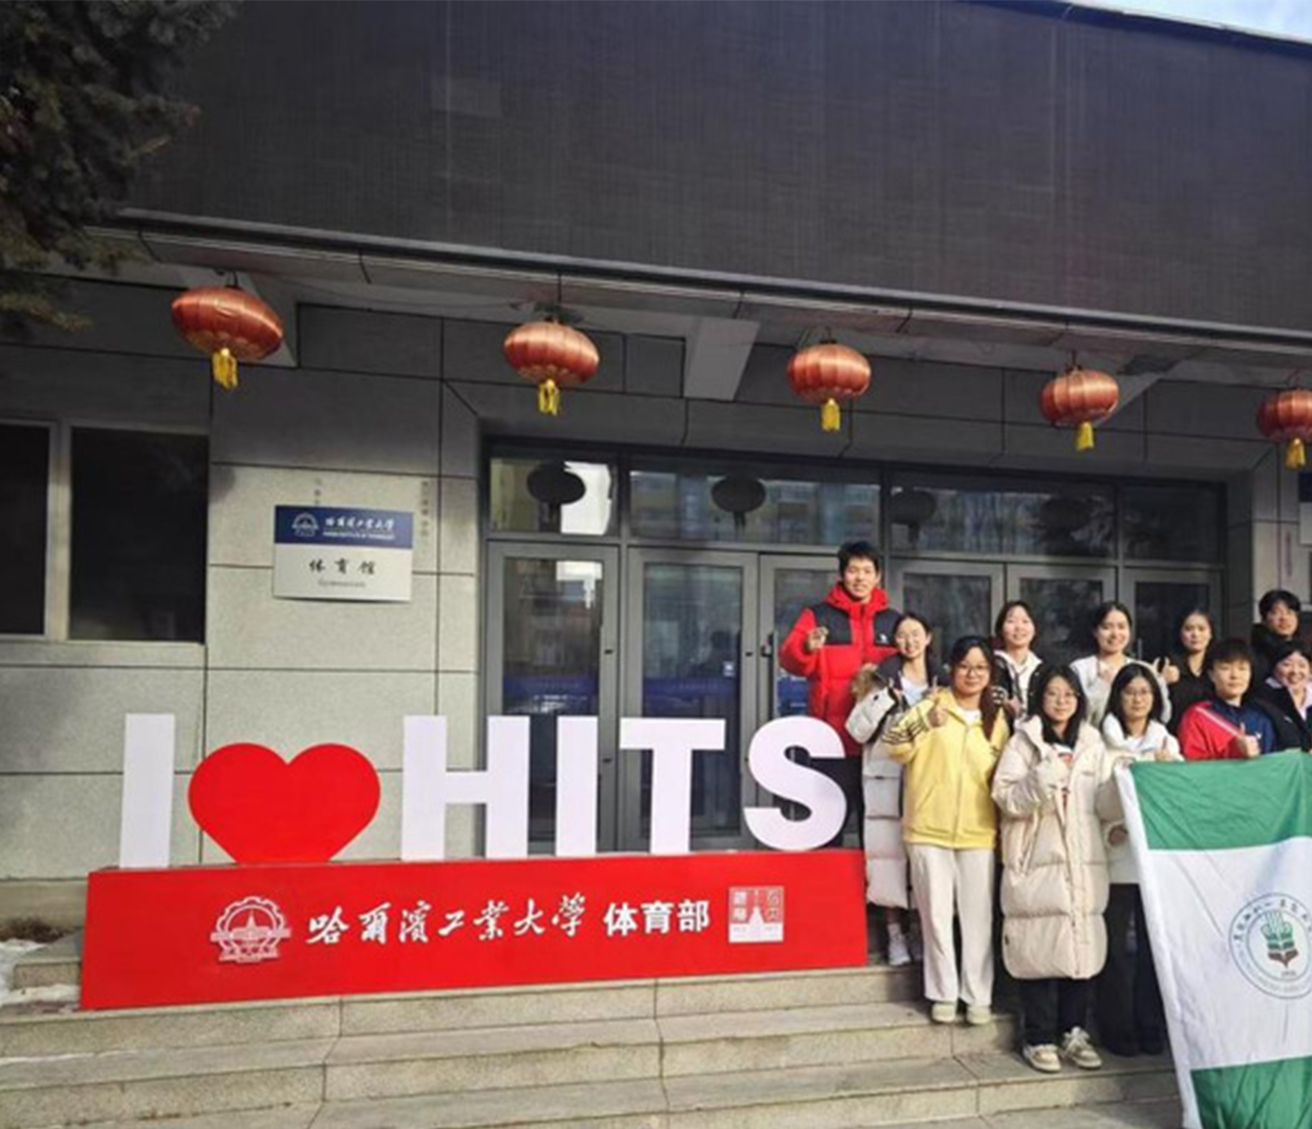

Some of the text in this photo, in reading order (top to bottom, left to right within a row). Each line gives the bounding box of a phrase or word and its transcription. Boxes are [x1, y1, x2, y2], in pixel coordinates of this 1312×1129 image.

[119, 713, 847, 868] I HITS
[603, 900, 711, 936] 体育部
